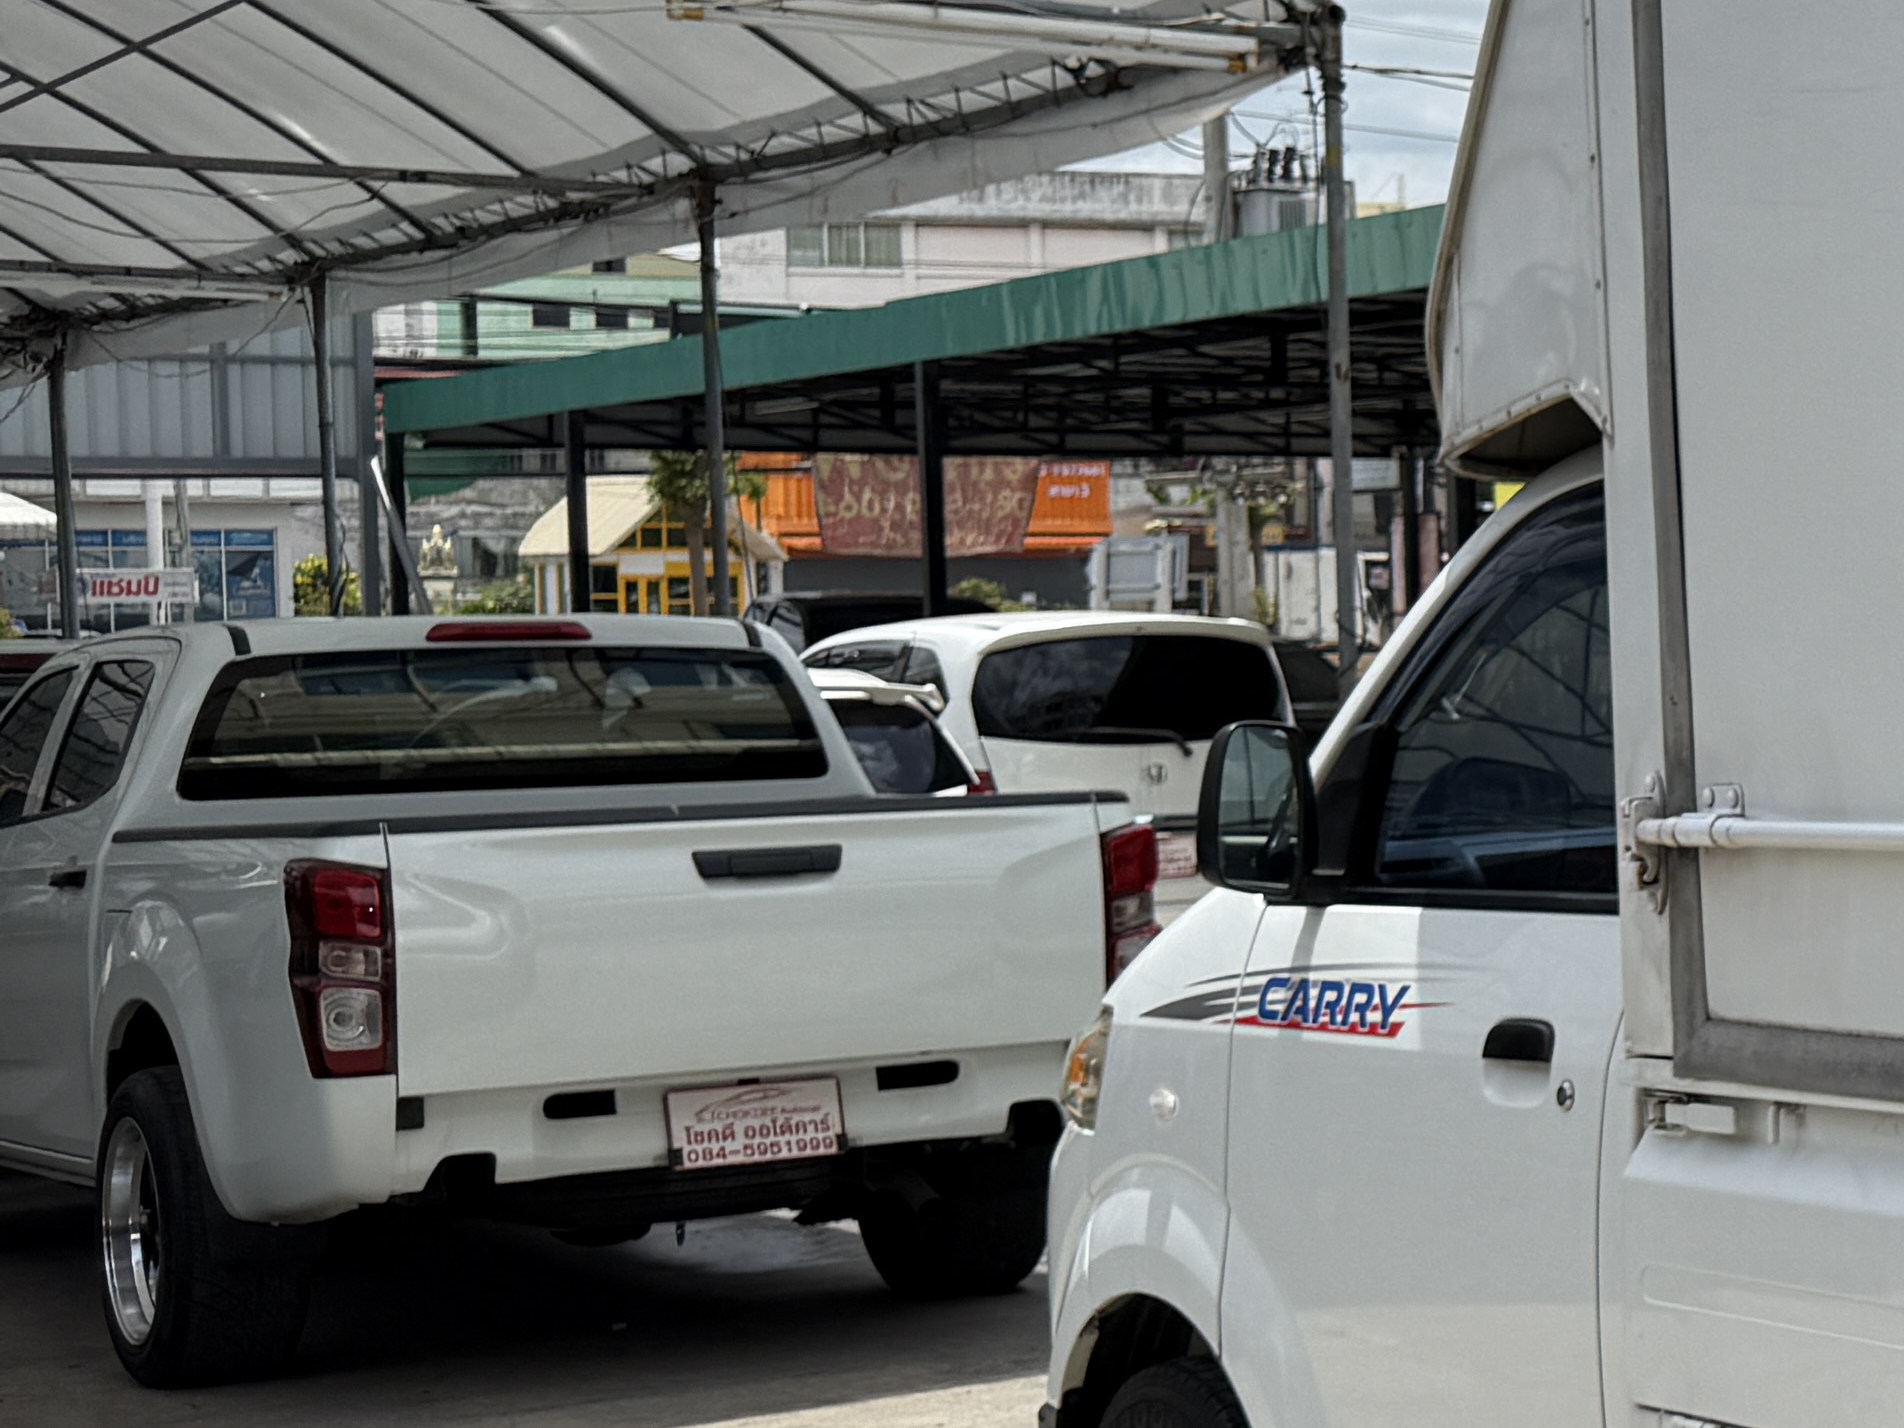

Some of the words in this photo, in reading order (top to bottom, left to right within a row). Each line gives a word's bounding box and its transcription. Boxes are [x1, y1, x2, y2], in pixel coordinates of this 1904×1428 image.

[1257, 976, 1411, 1032] CARRY
[685, 1121, 735, 1146] โชคดี
[686, 1135, 834, 1164] 084-5951999
